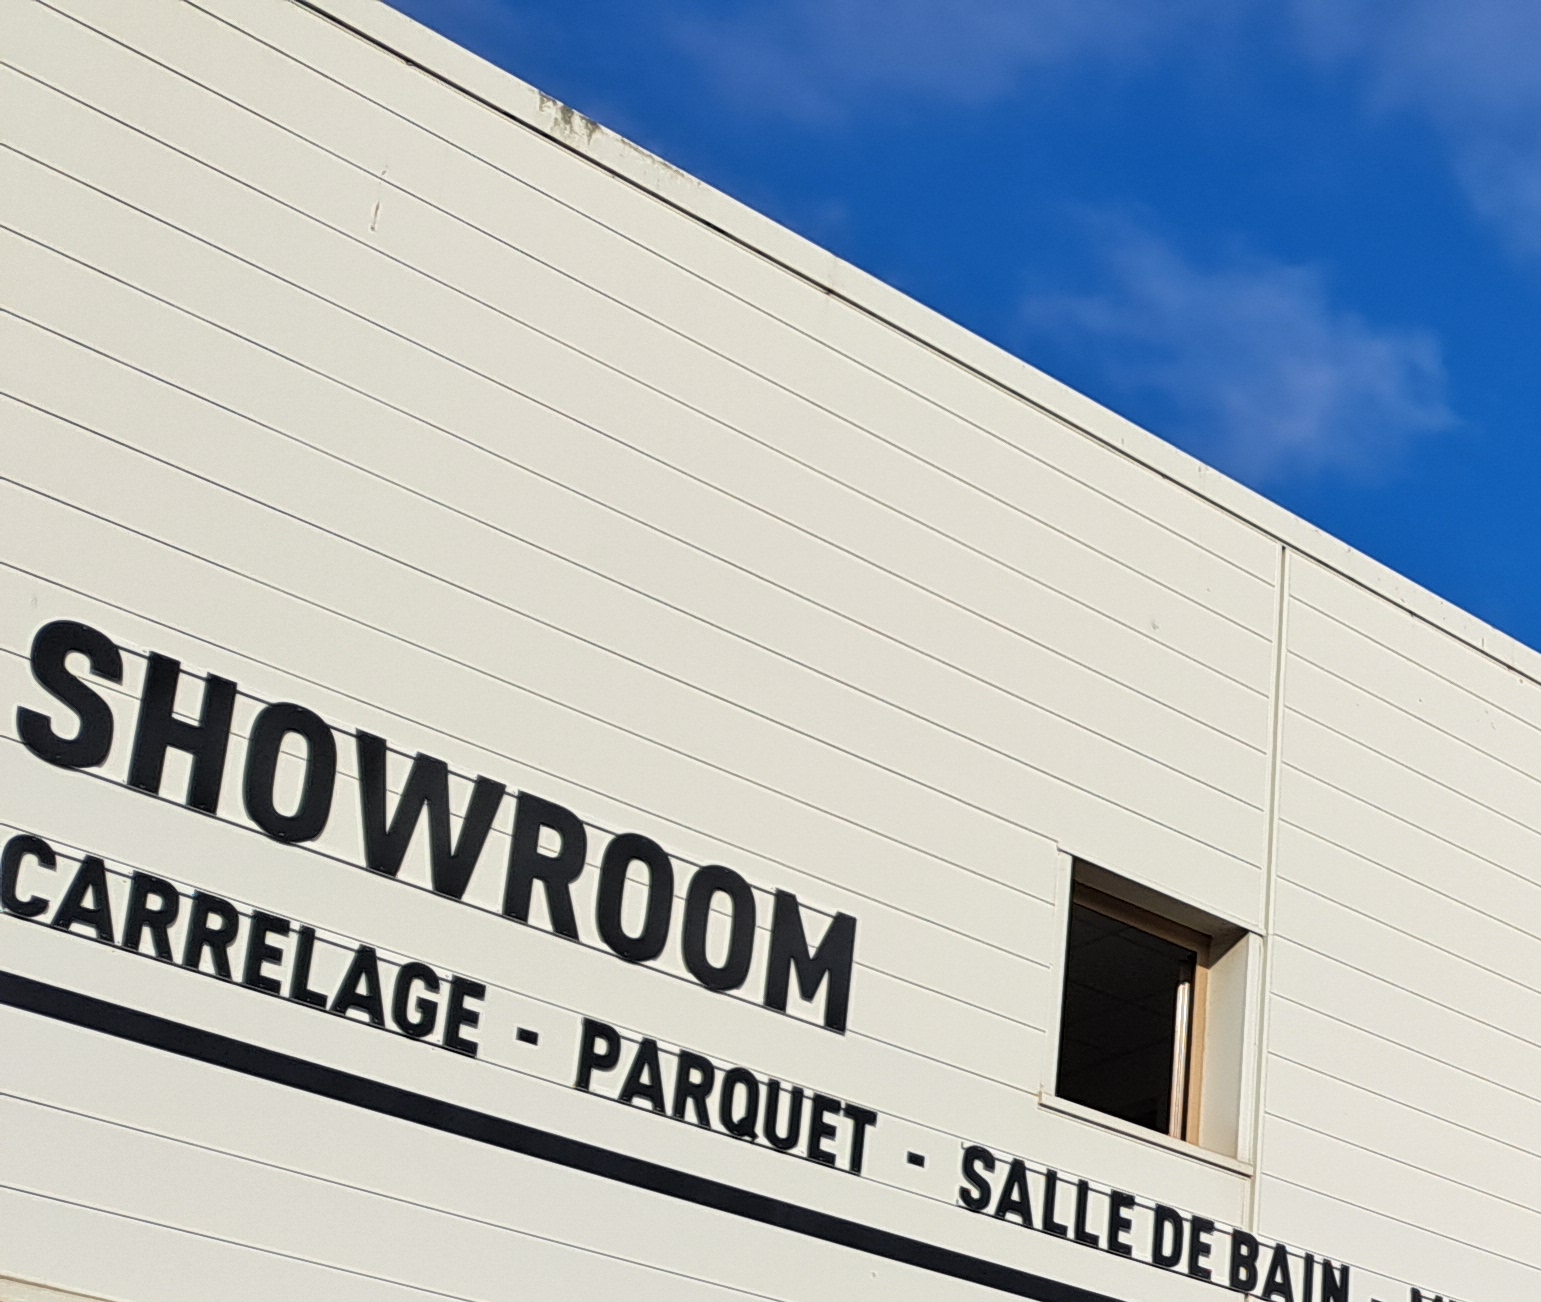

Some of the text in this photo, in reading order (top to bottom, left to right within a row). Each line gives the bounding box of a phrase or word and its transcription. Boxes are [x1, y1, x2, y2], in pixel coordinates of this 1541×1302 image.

[16, 620, 857, 1036] SHOWROOM
[0, 834, 487, 1060] CARRELAGE
[575, 1017, 878, 1176] PARQUET
[959, 1145, 1136, 1257] SALLE
[1152, 1203, 1215, 1282] DE
